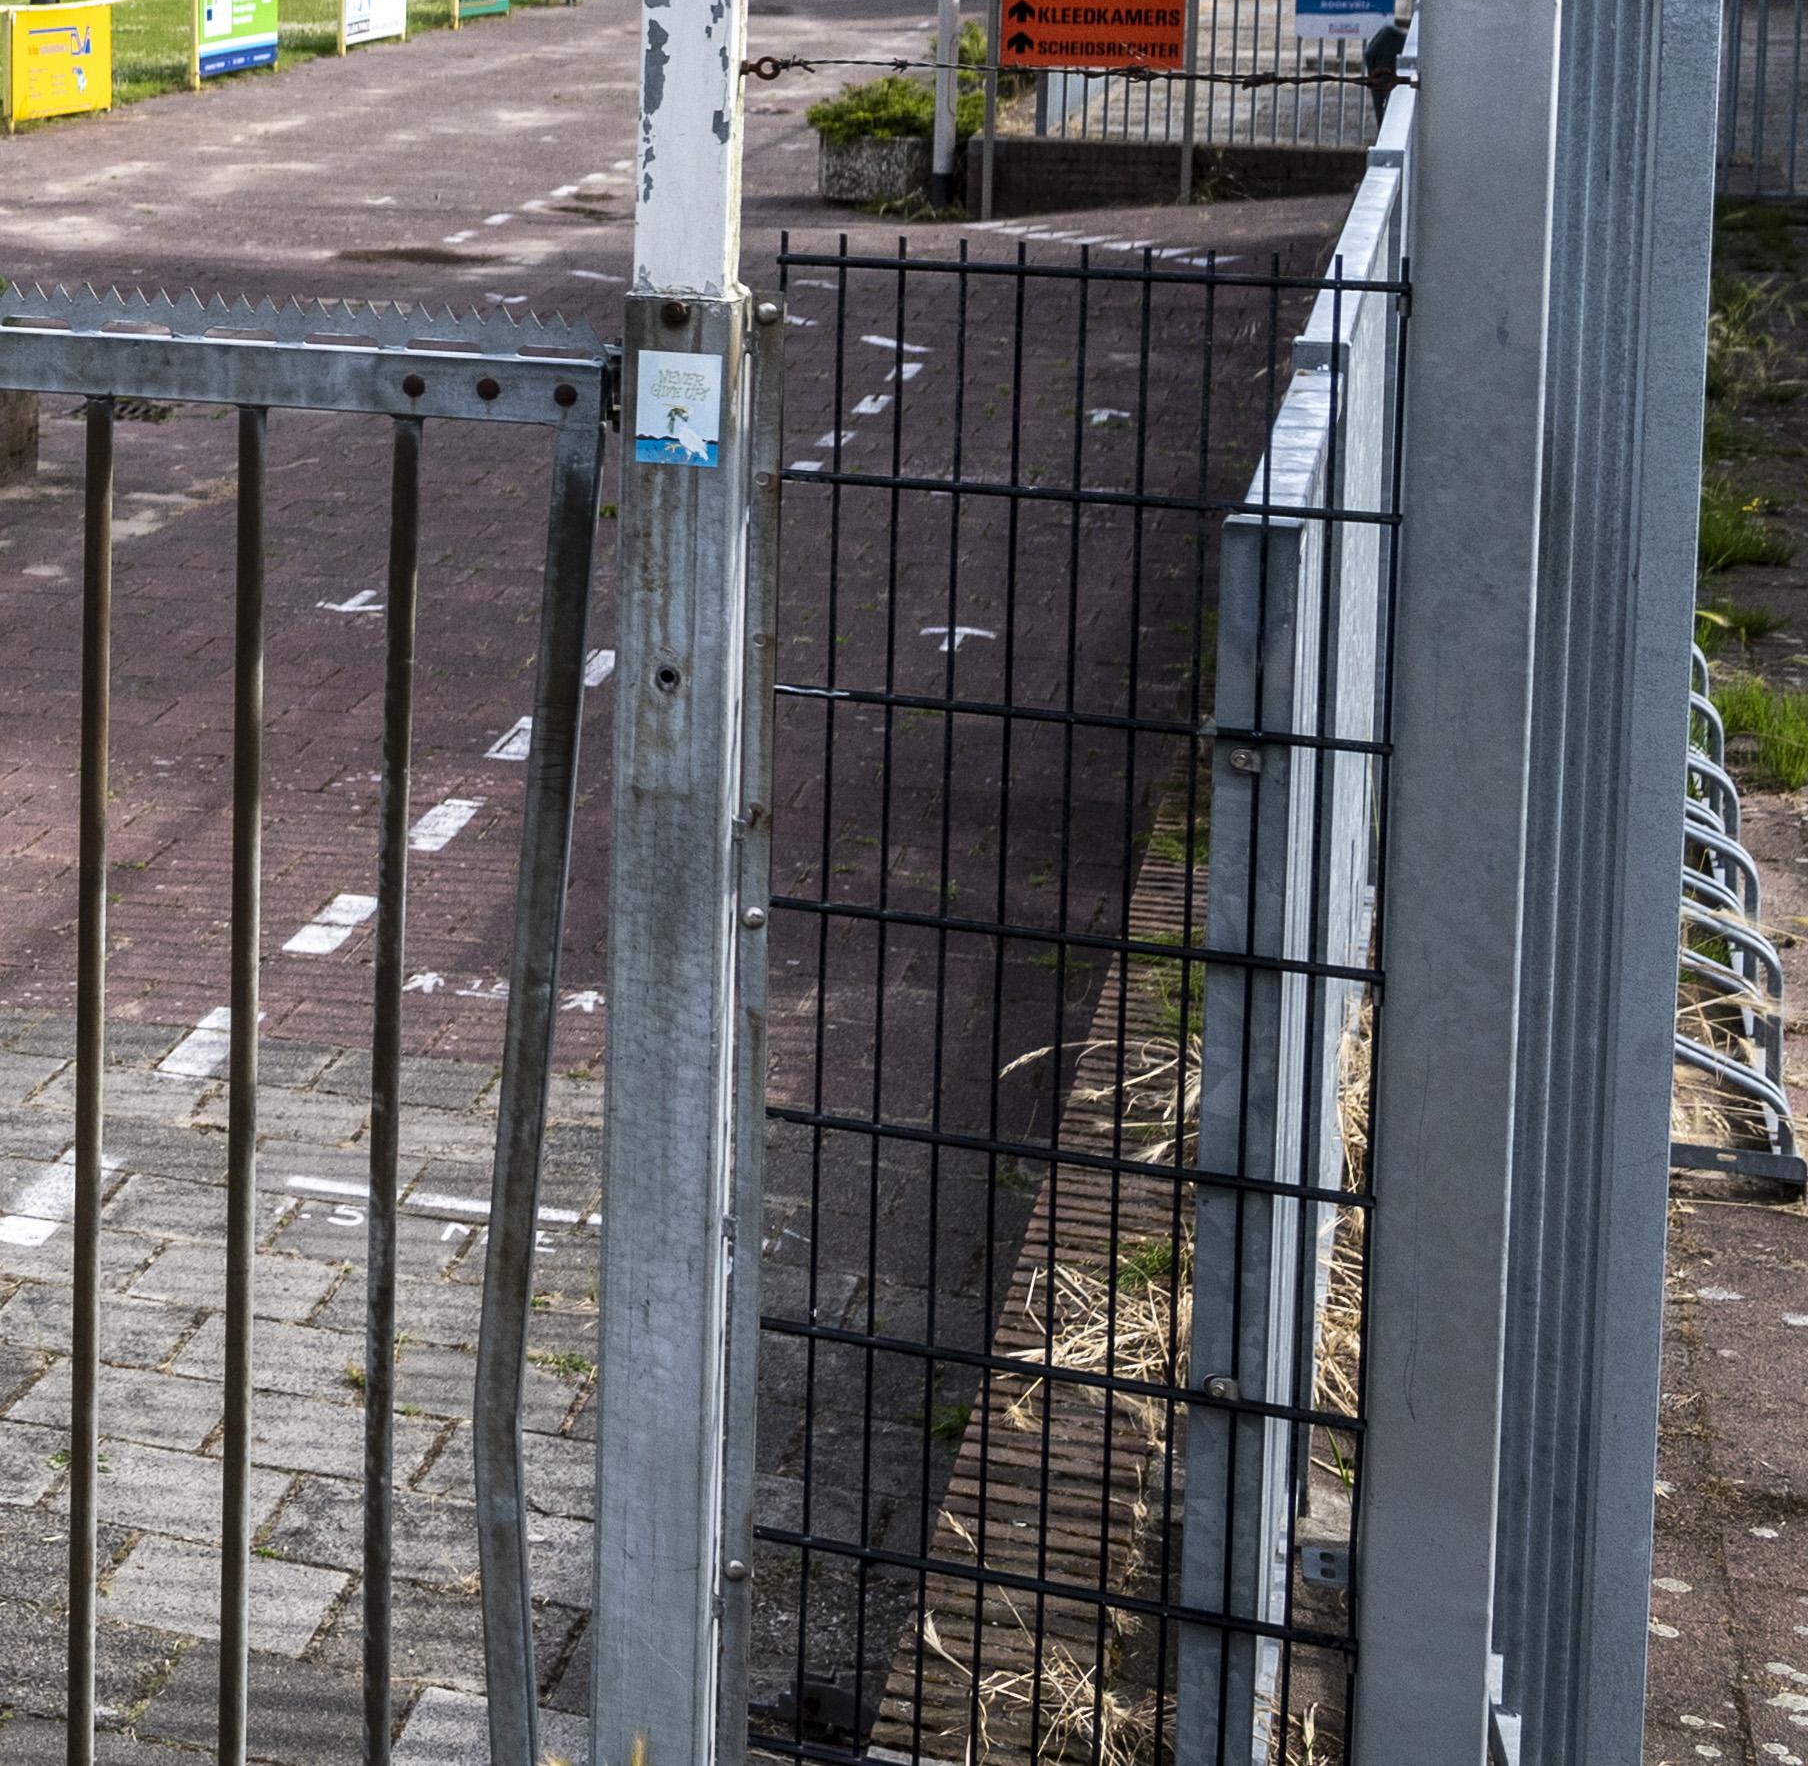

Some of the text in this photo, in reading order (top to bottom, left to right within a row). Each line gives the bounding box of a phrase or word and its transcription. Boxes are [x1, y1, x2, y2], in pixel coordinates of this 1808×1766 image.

[1038, 7, 1180, 26] KLEEDKAMERS
[1038, 41, 1179, 58] SCHEIDSRECHTER
[658, 370, 705, 386] NEVER
[650, 384, 682, 399] GIVE
